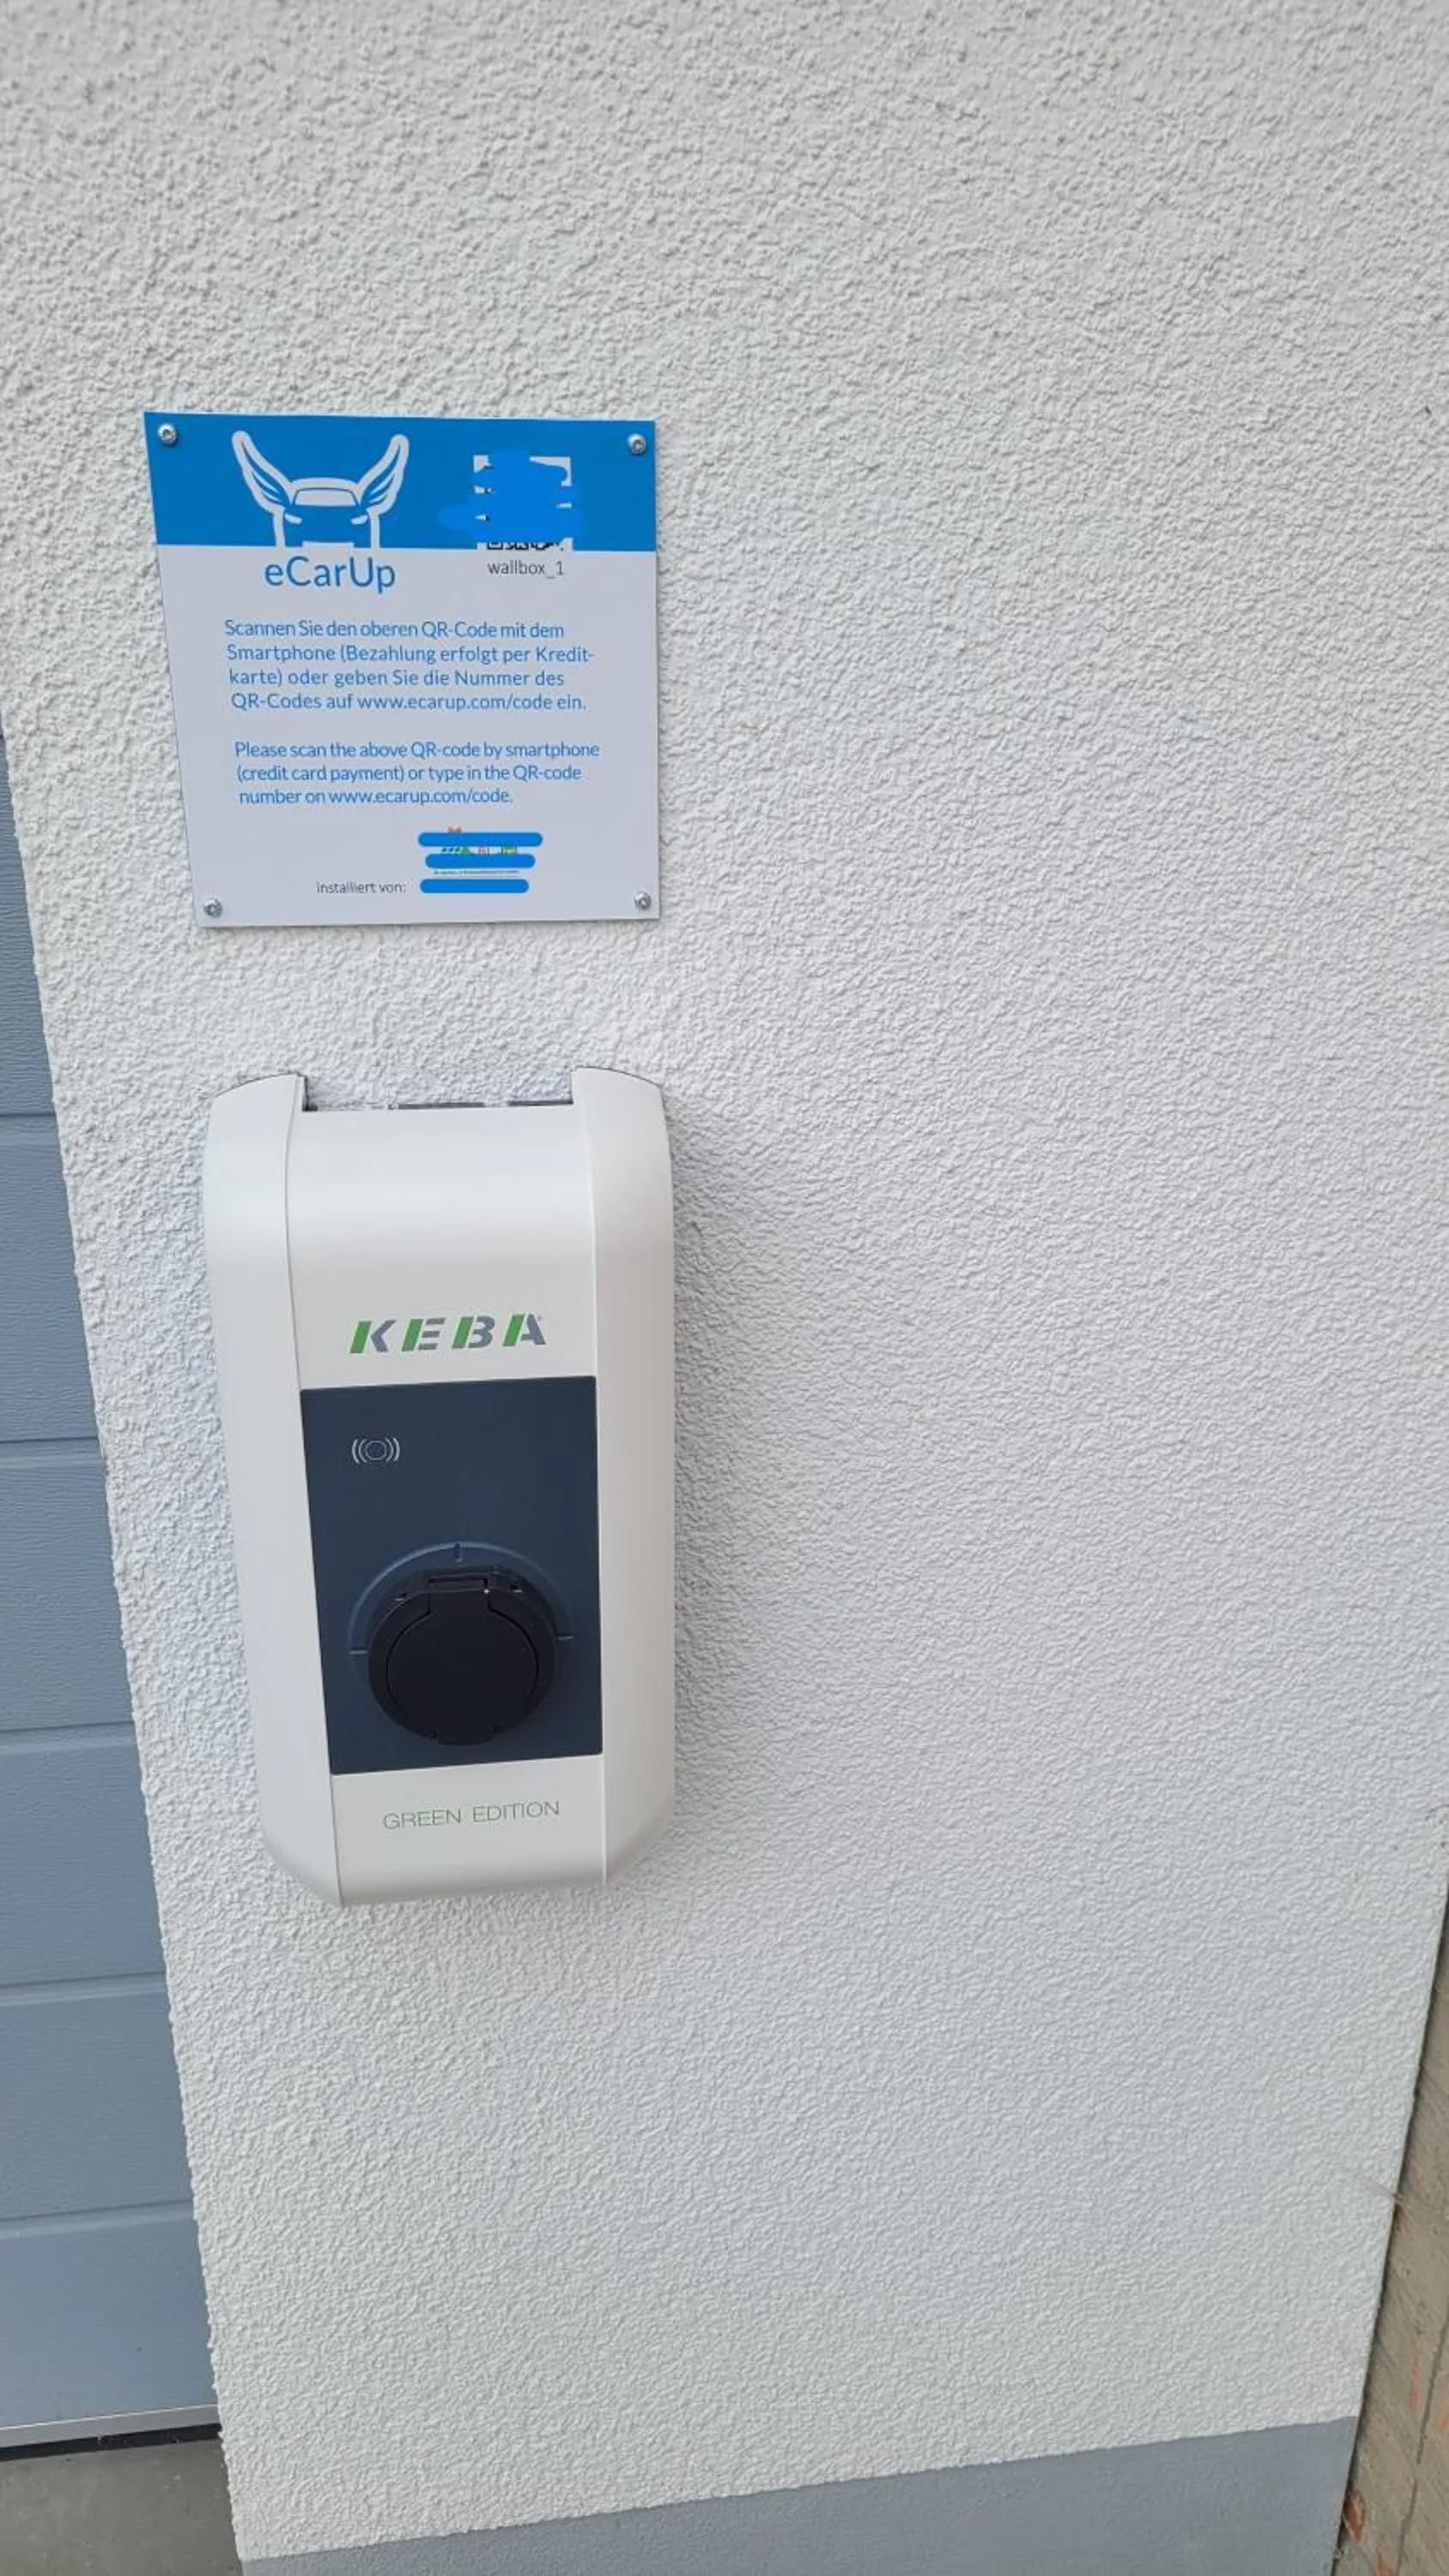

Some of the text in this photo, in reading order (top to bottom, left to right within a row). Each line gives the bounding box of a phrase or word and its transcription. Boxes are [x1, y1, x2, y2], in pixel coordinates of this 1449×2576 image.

[264, 556, 395, 592] eCarUp
[488, 558, 564, 580] wallbox_1
[224, 620, 564, 641] Scannen Sie den oberen QR-Code mit dem
[227, 644, 595, 665] Smartphone (Bezahlung erfolgt per Kredit-
[229, 668, 564, 688] karte) oder geben Sie die Nummer des
[231, 692, 587, 713] QR-Codes auf www.ecarup.com/code ein.
[234, 742, 600, 760] Please scan the above QR-code by smartphone
[237, 764, 582, 784] (credit card payment) or type in the QR-code
[239, 788, 512, 806] number on www.ecarup.com/code.
[379, 882, 405, 894] von:
[349, 1312, 547, 1355] KEBA
[383, 1800, 560, 1830] GREEN EDITION
